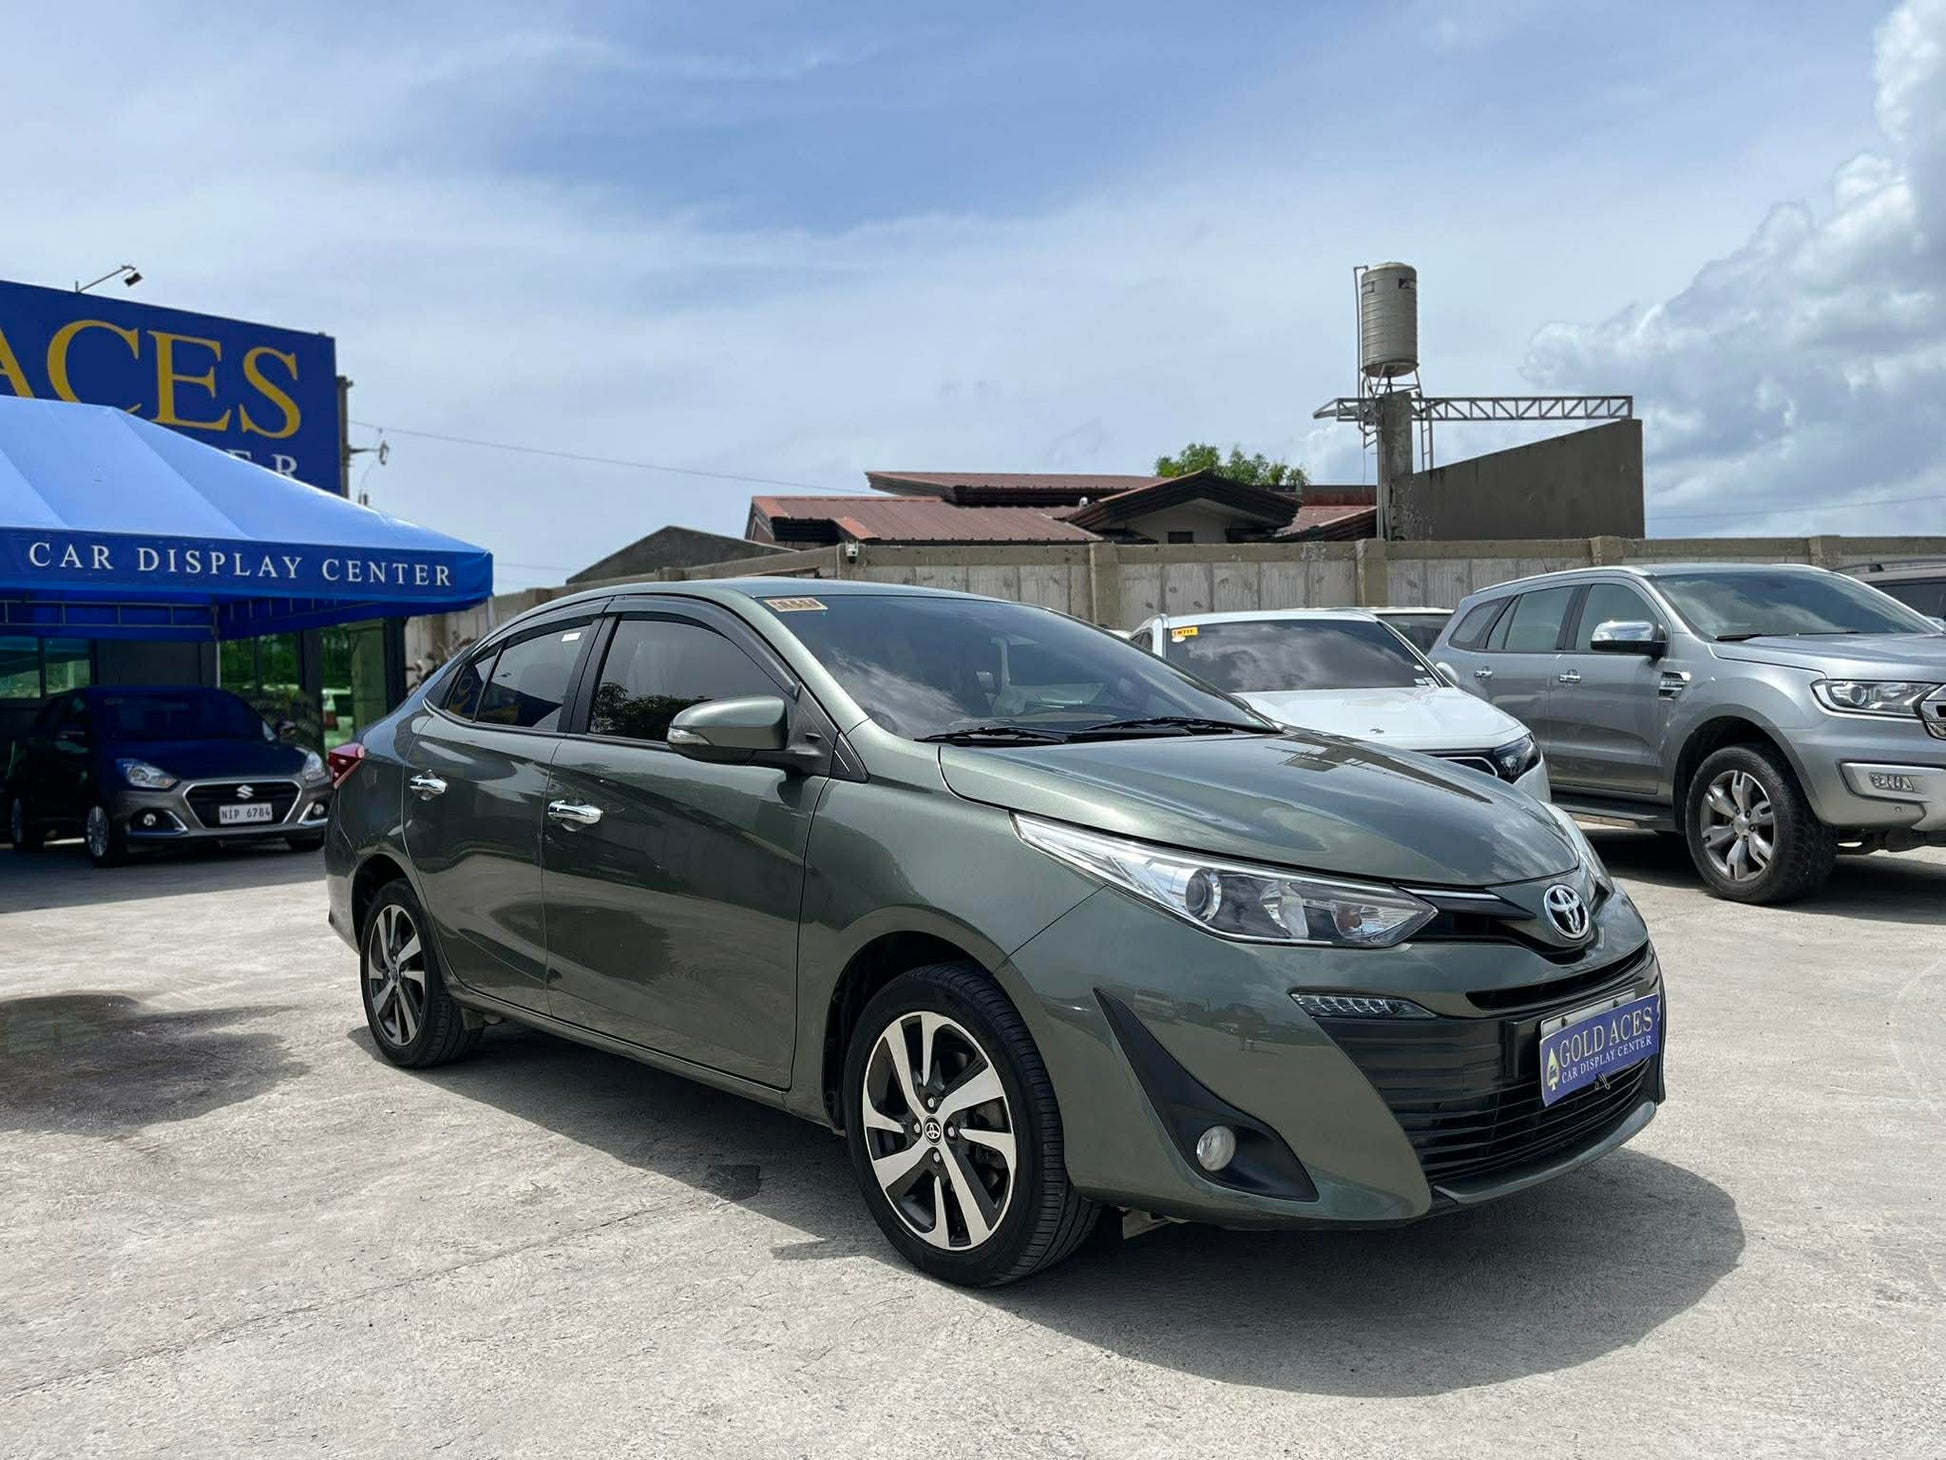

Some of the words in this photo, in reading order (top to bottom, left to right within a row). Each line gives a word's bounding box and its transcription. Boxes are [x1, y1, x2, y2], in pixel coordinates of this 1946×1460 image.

[29, 541, 114, 570] CAR
[137, 547, 302, 579] DISPLAY
[321, 558, 452, 587] CENTER
[221, 809, 240, 820] NIP
[1559, 1025, 1604, 1068] GOLD
[1609, 1006, 1653, 1046] ACES
[1561, 1068, 1578, 1084] CAR
[1580, 1050, 1616, 1073] DISPLAY
[1617, 1035, 1653, 1057] CENTER
